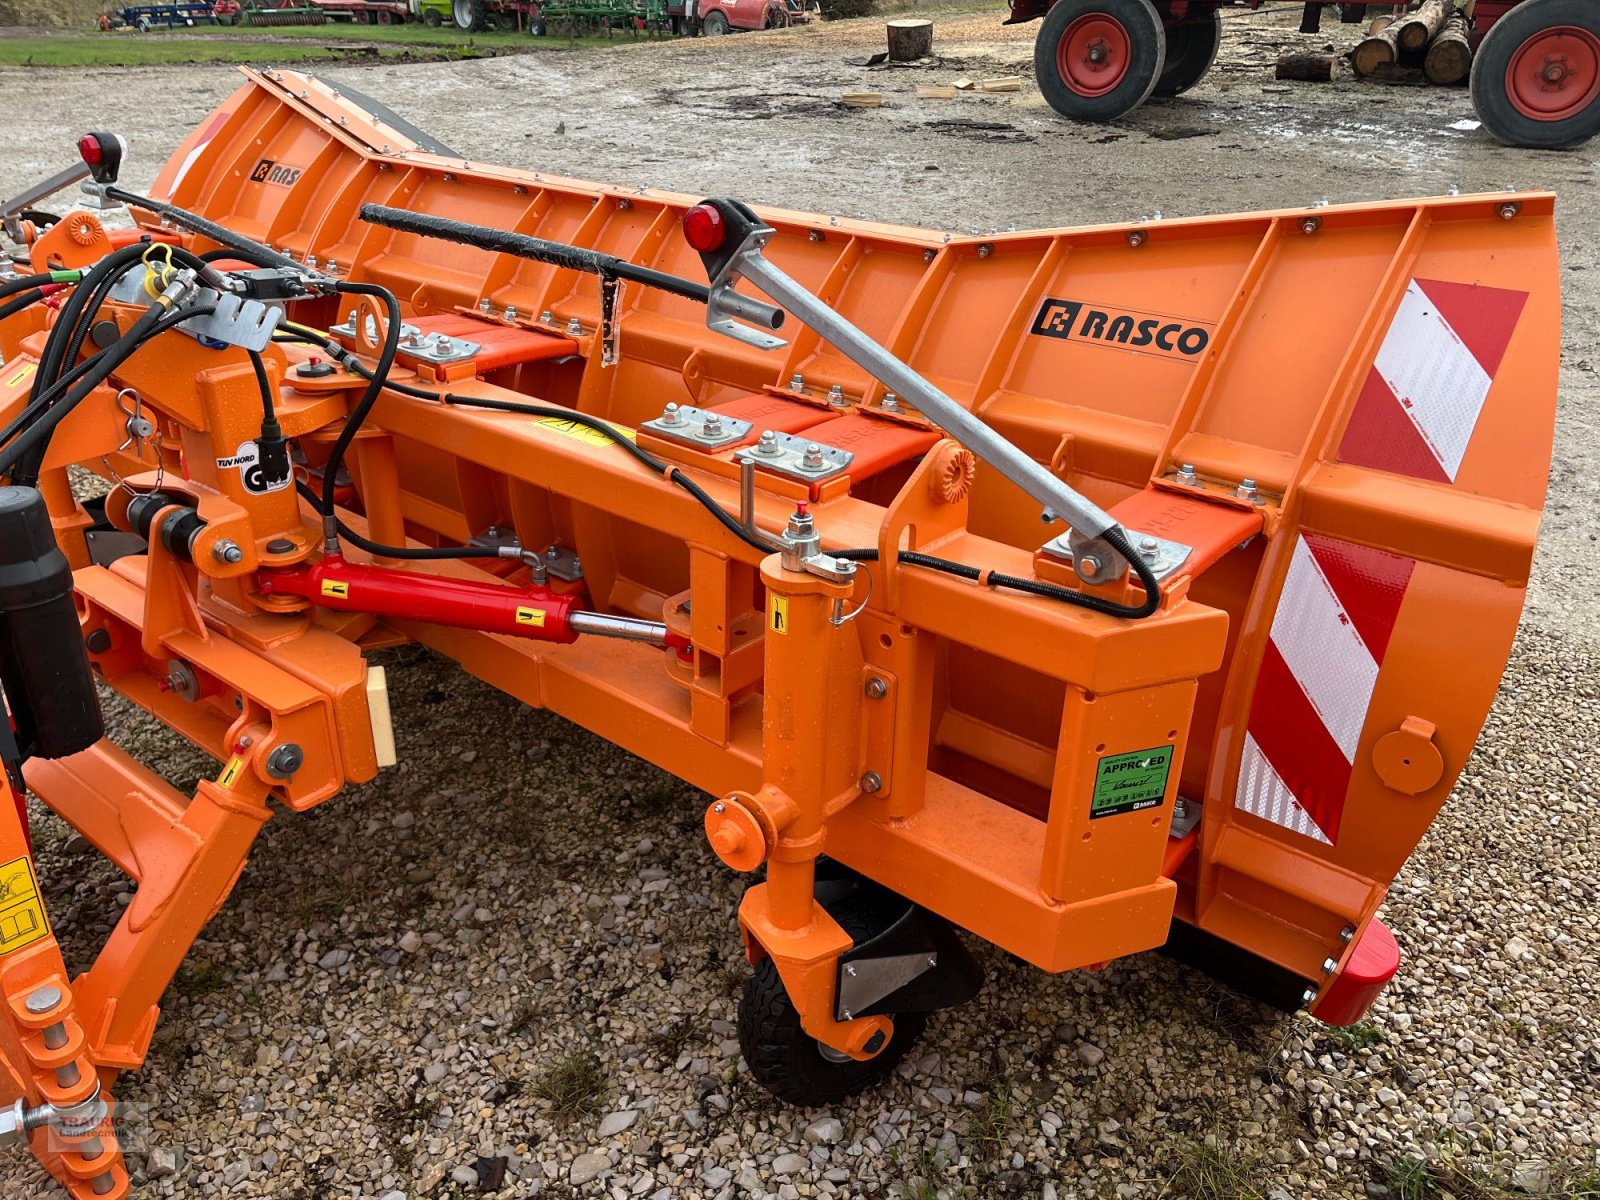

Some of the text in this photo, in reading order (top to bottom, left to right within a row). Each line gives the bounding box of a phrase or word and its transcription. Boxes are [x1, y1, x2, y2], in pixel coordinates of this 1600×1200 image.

[267, 165, 303, 186] RAS
[1079, 310, 1209, 355] RASCO
[1401, 397, 1413, 409] 3M
[234, 454, 255, 465] NORD
[1338, 612, 1349, 625] 3M
